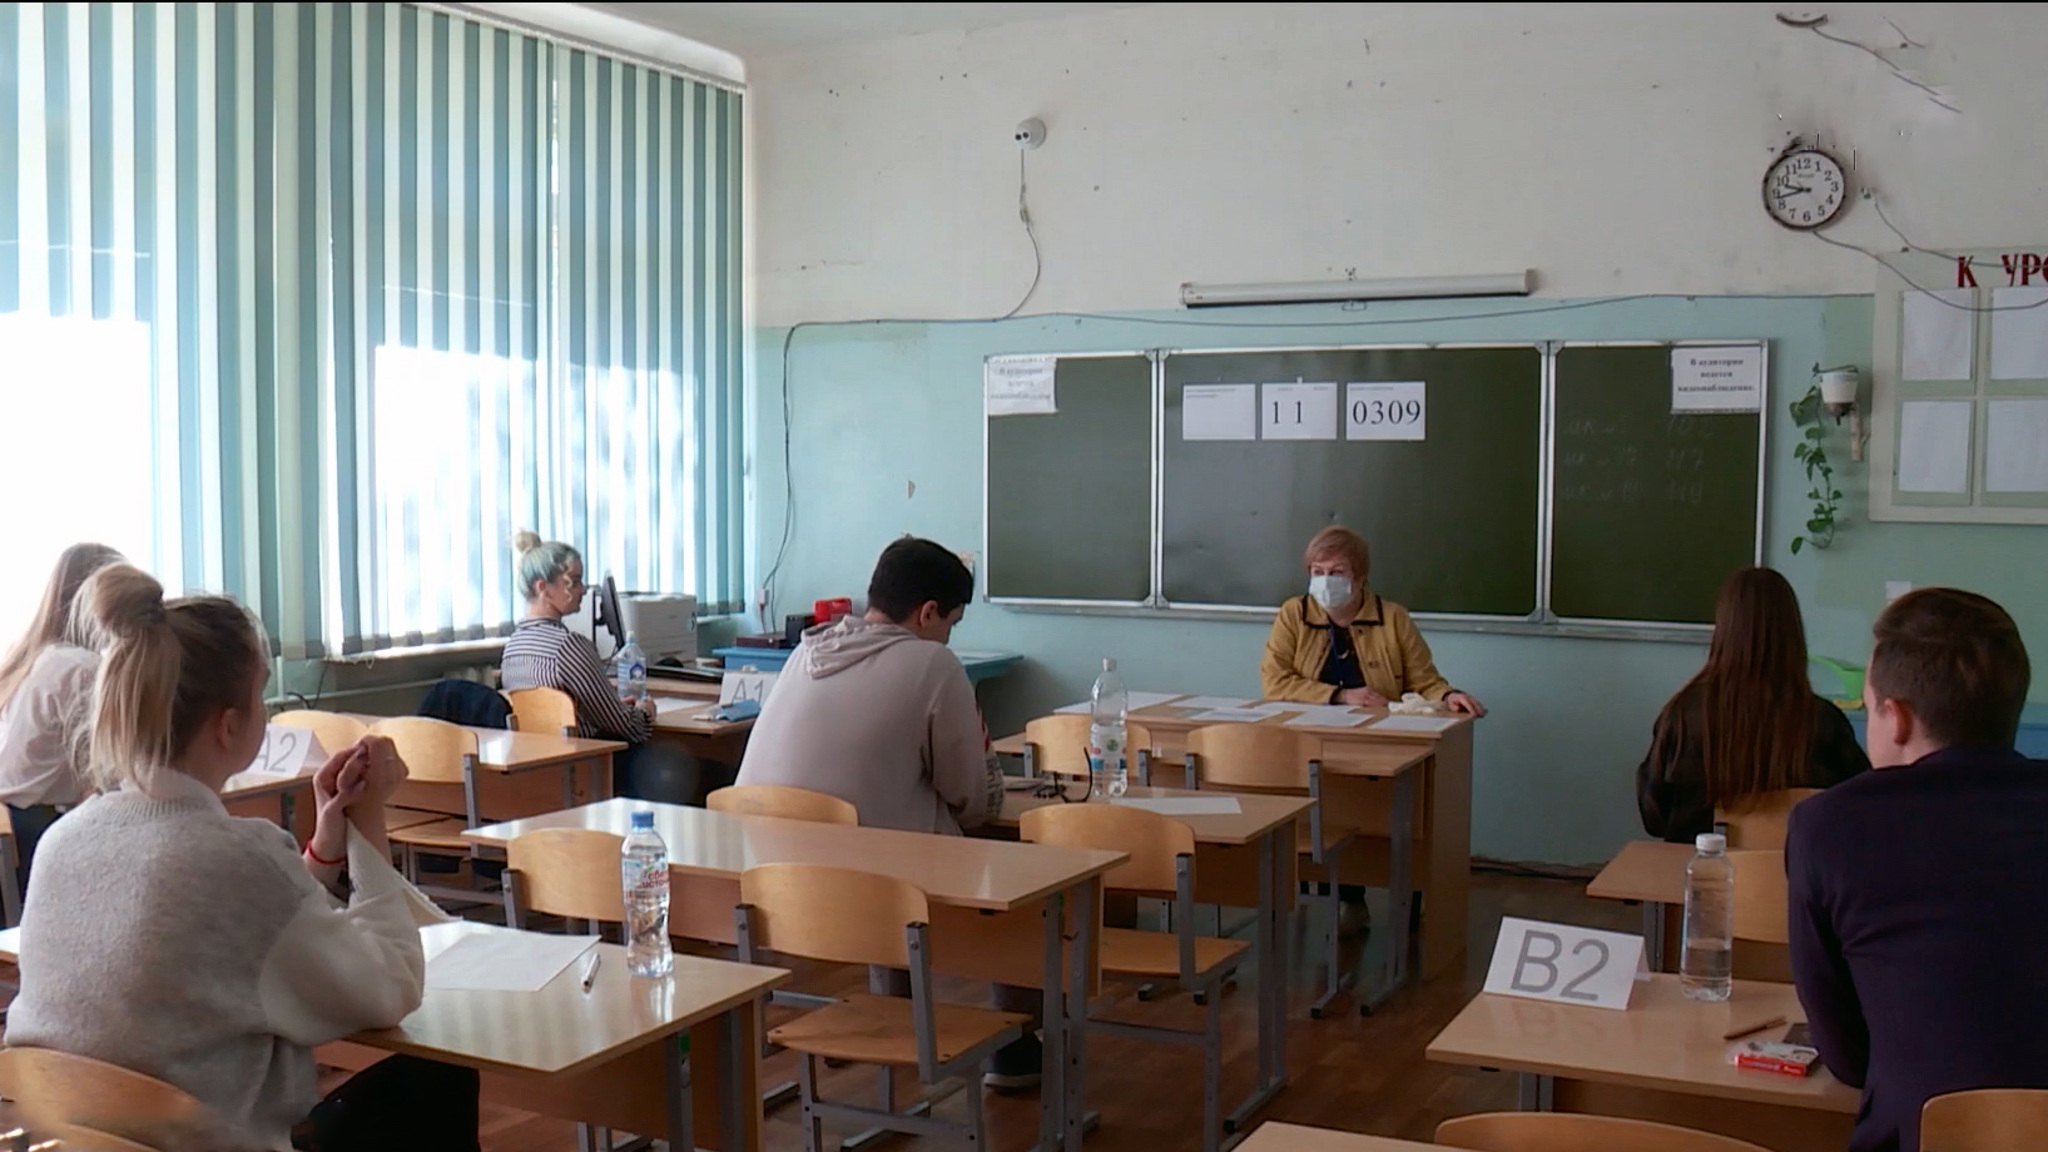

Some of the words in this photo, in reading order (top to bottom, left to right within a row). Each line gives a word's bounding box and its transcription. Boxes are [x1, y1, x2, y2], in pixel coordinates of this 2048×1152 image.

[1785, 163, 1798, 175] 11
[1797, 158, 1811, 170] 12
[1815, 161, 1821, 172] 1
[1777, 175, 1789, 187] 10
[1824, 170, 1832, 181] 2
[1831, 181, 1839, 193] 3
[1772, 188, 1781, 199] 9
[1778, 199, 1786, 210] 8
[1826, 194, 1833, 205] 4
[1789, 208, 1796, 219] 7
[1803, 210, 1811, 221] 6
[1818, 205, 1825, 216] 5
[1957, 255, 1978, 288] К
[2001, 253, 2048, 286] УР
[1352, 400, 1421, 425] 0309
